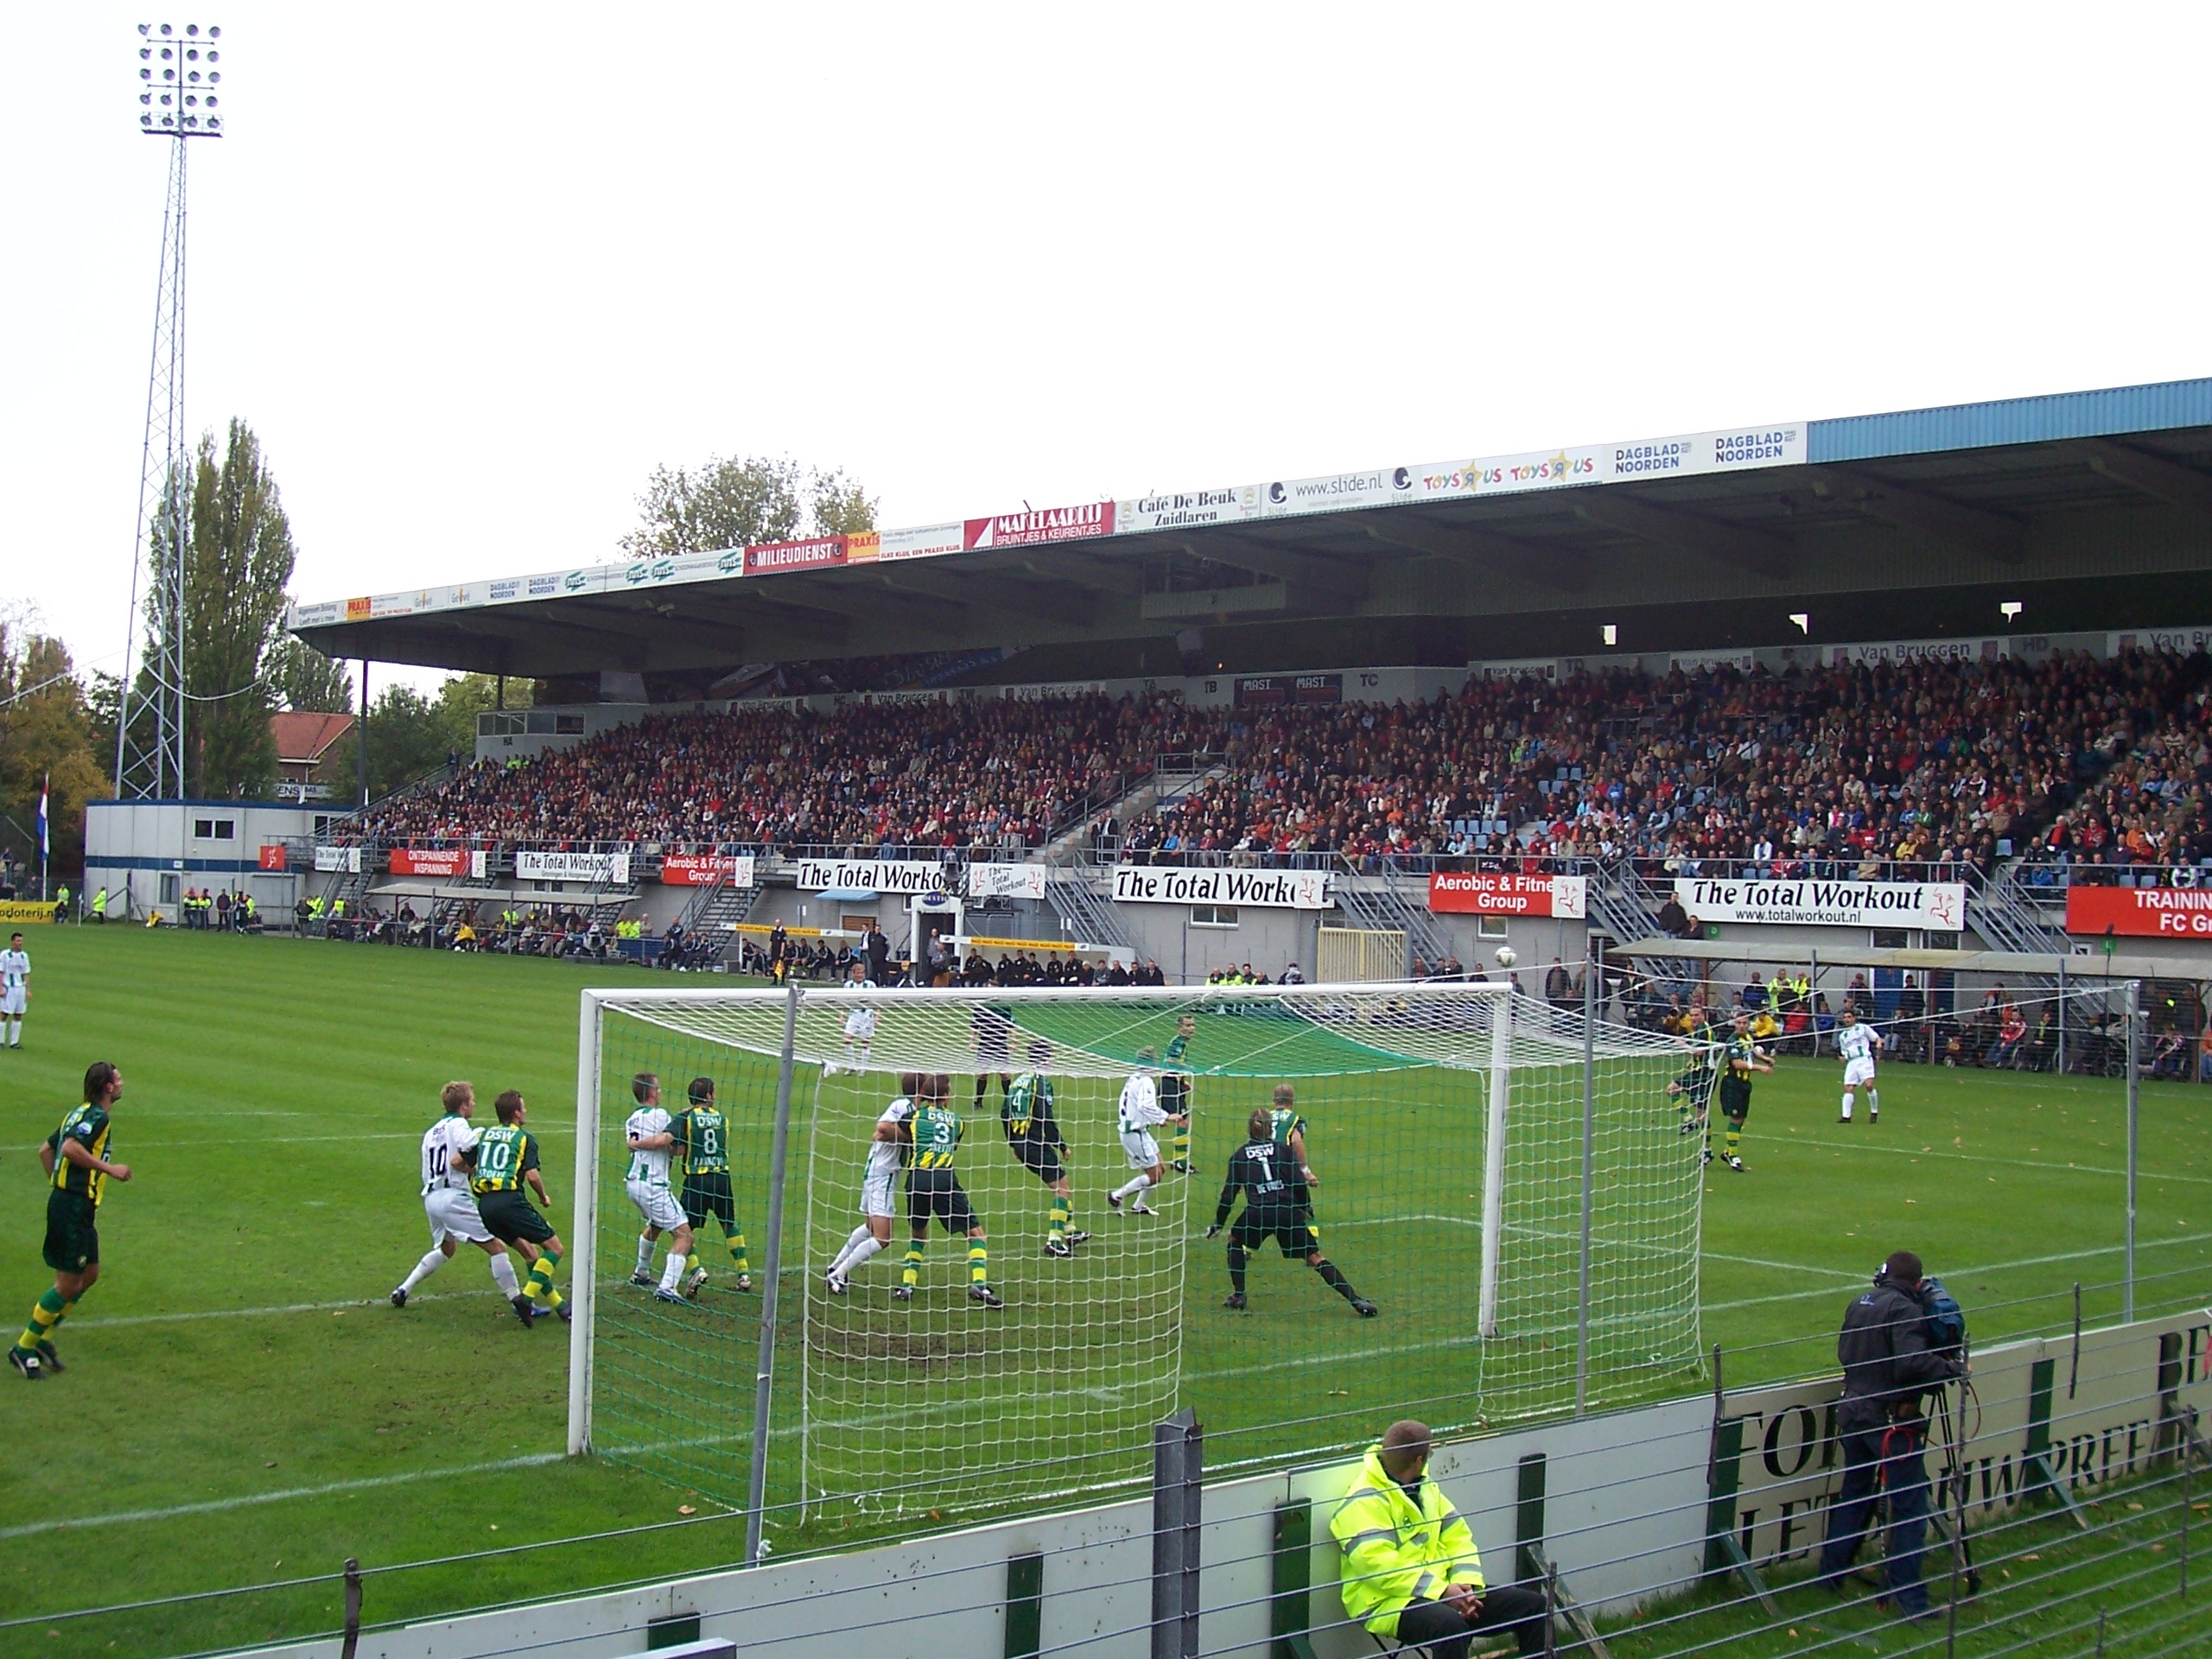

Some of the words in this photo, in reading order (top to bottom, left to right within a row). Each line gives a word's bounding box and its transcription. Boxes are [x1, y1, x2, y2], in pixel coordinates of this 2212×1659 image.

[1716, 432, 1783, 449] DAGBLAD
[1617, 443, 1679, 461] DAGBLAD
[1716, 445, 1783, 463] NOORDEN
[1510, 463, 1549, 481] TOYS
[1573, 458, 1594, 474] US
[1616, 456, 1679, 474] NOORDEN
[1296, 474, 1382, 497] www.slide.nl
[1423, 473, 1460, 490] TOYS
[1483, 468, 1503, 484] US
[1138, 498, 1167, 513] Café
[1173, 494, 1192, 510] De
[1198, 489, 1236, 506] Beuk
[997, 504, 1102, 534] MAKELAARDIJ
[1154, 511, 1217, 526] Zuidlaren
[849, 532, 880, 549] PRAXIS
[996, 531, 1039, 546] BRUINTJES
[1040, 531, 1047, 540] &
[1048, 524, 1102, 540] KEURENTJES
[757, 543, 832, 567] MILIEUDIENST
[490, 582, 516, 591] DAGBLAD
[529, 576, 556, 587] DAGBLAD
[490, 590, 515, 599] NOORDEN
[1859, 645, 1889, 661] Van
[1243, 679, 1271, 691] MAST
[1296, 677, 1325, 690] MAST
[1360, 673, 1378, 687] TC
[408, 850, 460, 862] ONTSPANNENDE
[524, 854, 541, 869] The
[543, 854, 567, 870] Total
[666, 857, 699, 868] Aerobic
[700, 858, 708, 869] &
[801, 863, 832, 886] The
[836, 863, 880, 887] Total
[884, 865, 944, 891] Worko
[988, 867, 1001, 877] The
[992, 873, 1010, 886] Total
[995, 878, 1027, 894] Workout
[1116, 870, 1158, 898] The
[1163, 871, 1219, 900] Total
[1434, 874, 1495, 892] Aerobic
[1501, 876, 1511, 893] &
[1516, 877, 1554, 893] Fitne
[1478, 893, 1527, 912] Group
[1694, 880, 1737, 906] The
[1743, 881, 1803, 907] Total
[1812, 883, 1923, 910] Workout
[1736, 909, 1861, 924] www.totalworkout.nl
[2161, 914, 2187, 931] FC
[1012, 1089, 1023, 1112] 4
[696, 1116, 722, 1128] DSW
[927, 1111, 956, 1123] DSW
[485, 1129, 516, 1143] DSW
[703, 1128, 717, 1155] 8
[933, 1122, 950, 1145] 3
[429, 1143, 448, 1178] 10
[480, 1141, 510, 1170] 10
[1246, 1147, 1274, 1160] DSW
[1257, 1156, 1273, 1181] 1
